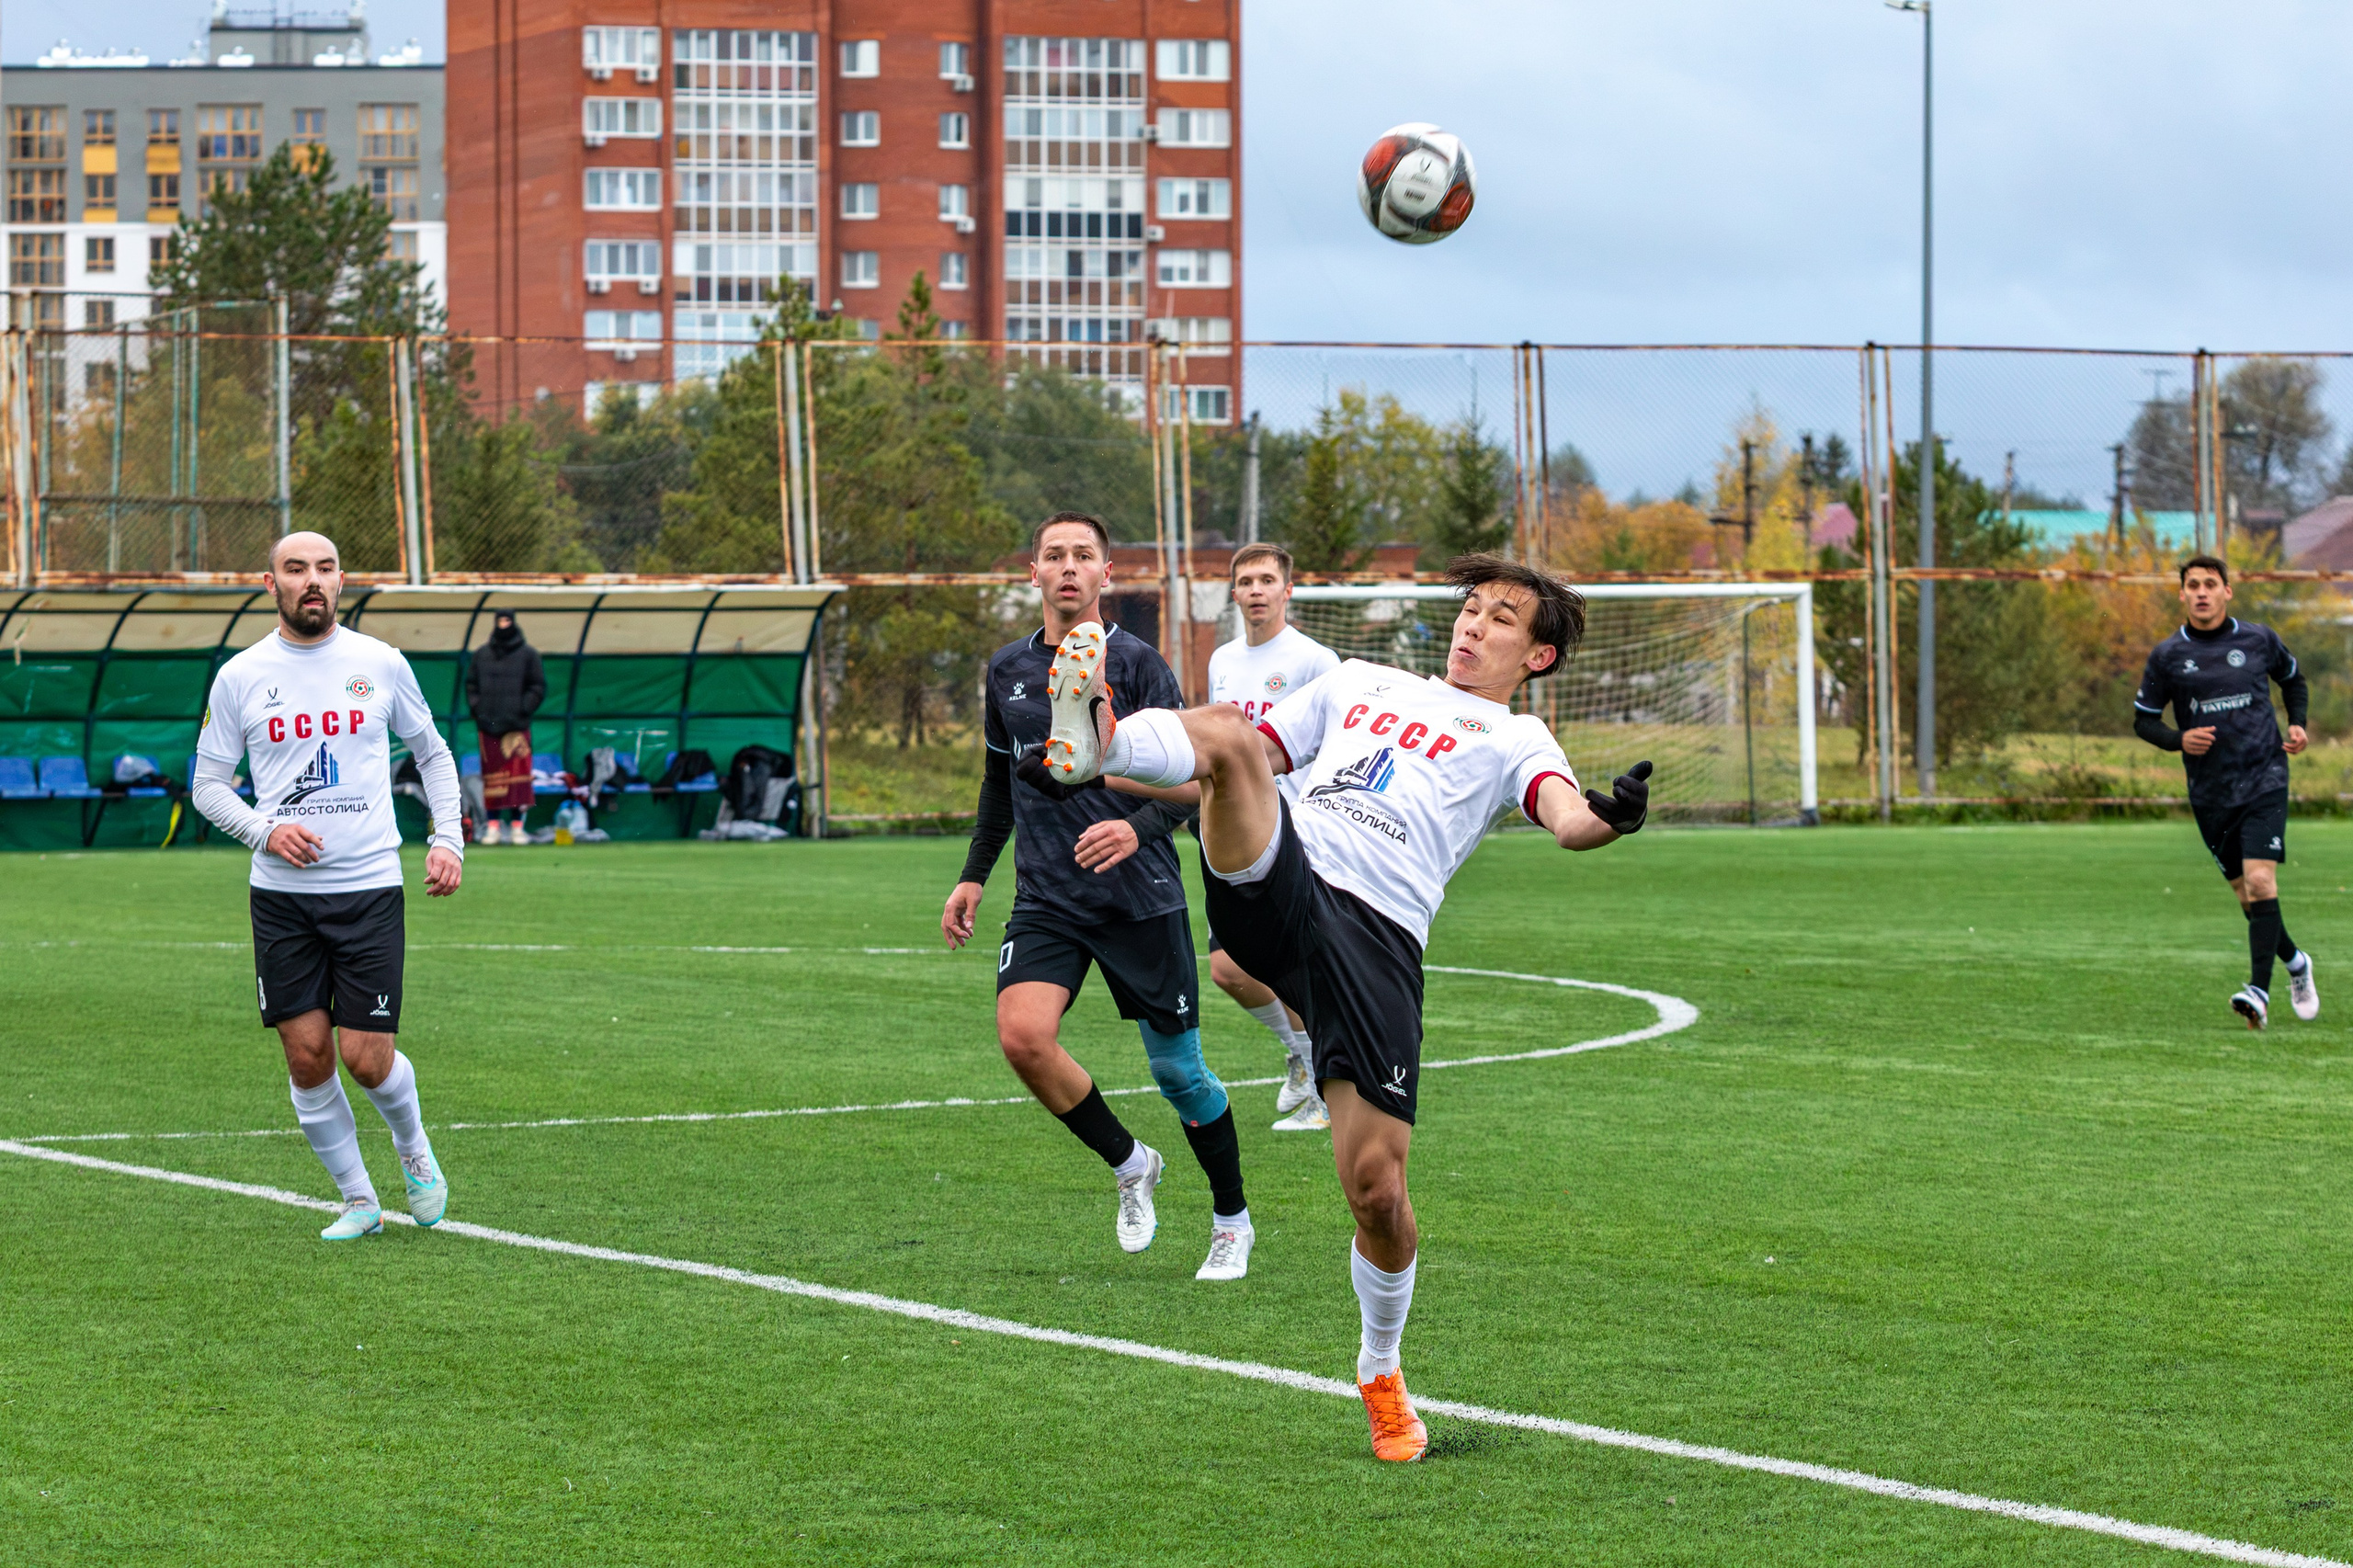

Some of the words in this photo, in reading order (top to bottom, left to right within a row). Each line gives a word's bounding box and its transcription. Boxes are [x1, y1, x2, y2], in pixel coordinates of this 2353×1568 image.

[268, 710, 364, 743] СССР
[1343, 703, 1458, 761] СССР
[277, 802, 369, 817] АВТОСТОЛИЦА
[1301, 798, 1407, 845] ТОСТОЛИЦА
[1336, 794, 1364, 808] ГРУППА
[1366, 805, 1407, 829] КОМПАНИЙ
